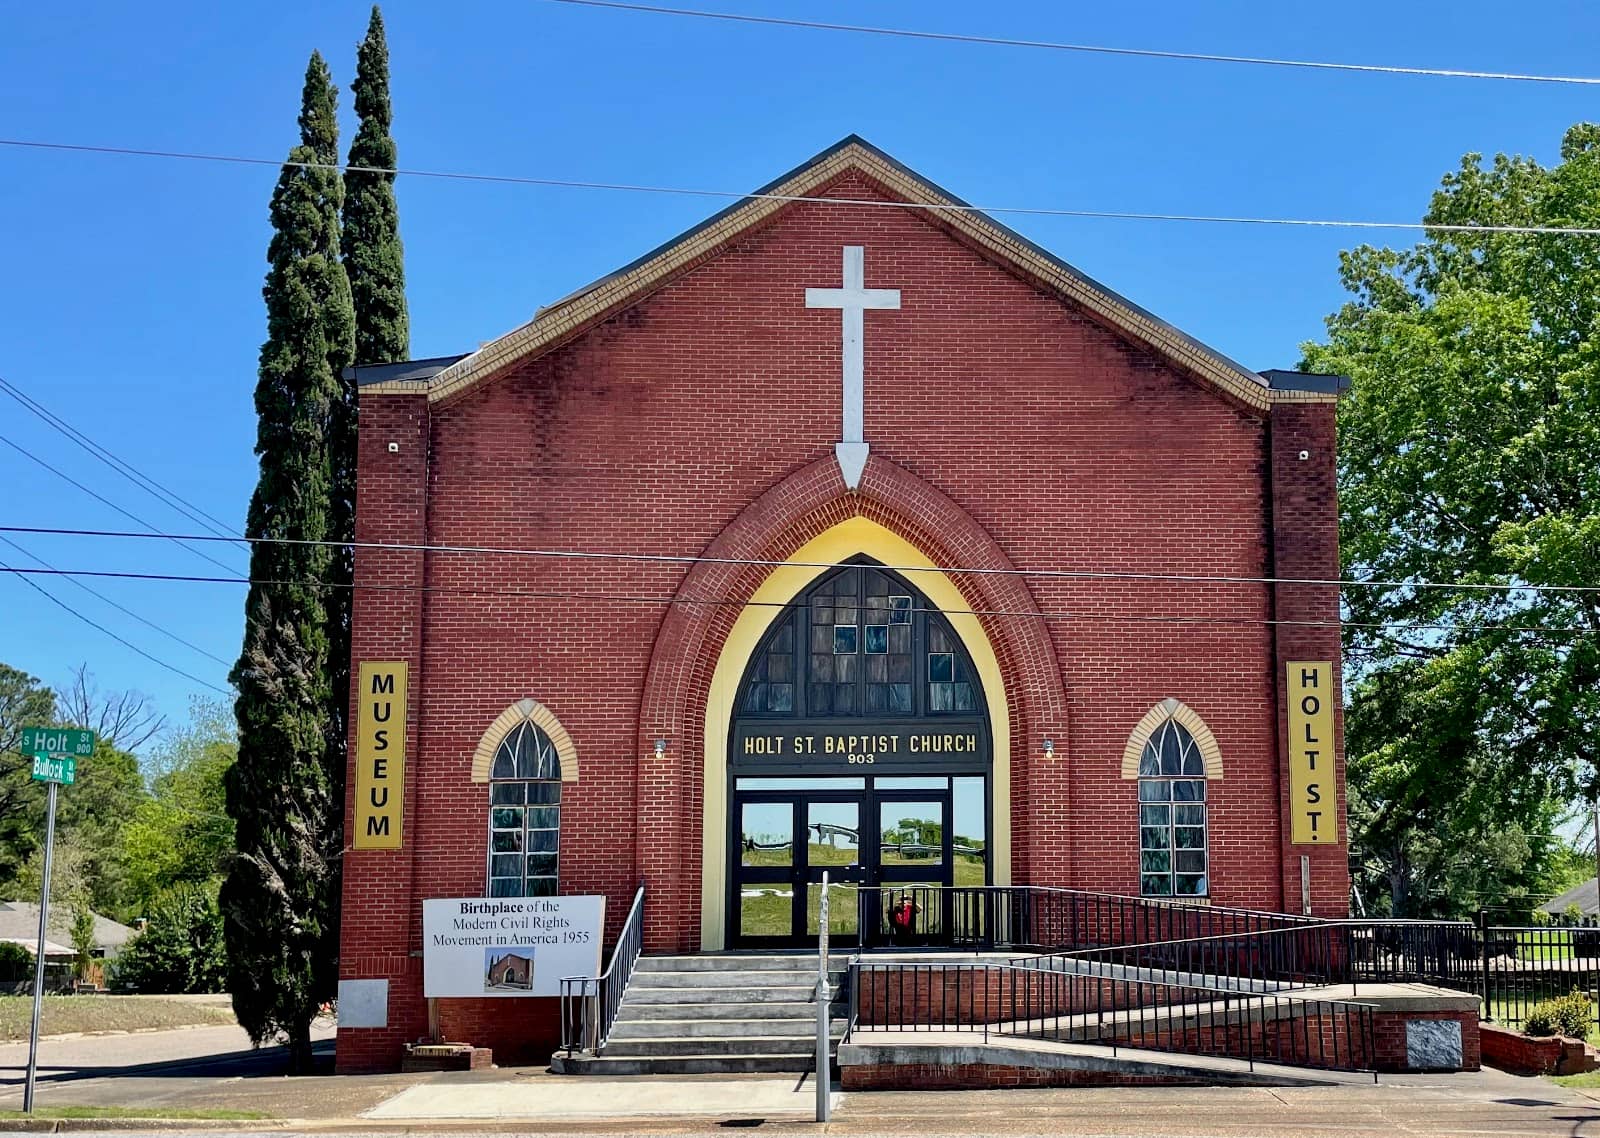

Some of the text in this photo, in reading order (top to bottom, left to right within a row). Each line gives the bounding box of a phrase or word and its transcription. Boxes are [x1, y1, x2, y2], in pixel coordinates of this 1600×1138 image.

[23, 732, 90, 751] S Holt St
[76, 743, 91, 754] 900
[744, 734, 976, 754] HOLT ST. BAPTIST CHURCH
[367, 674, 394, 836] MUSEUM
[847, 753, 875, 764] 903
[1301, 669, 1322, 841] HOLT ST.
[33, 756, 64, 779] Bullock
[460, 900, 560, 916] Birthplace of the
[453, 916, 570, 932] Modern Civil Rights
[433, 931, 590, 946] Movement in America 1955
